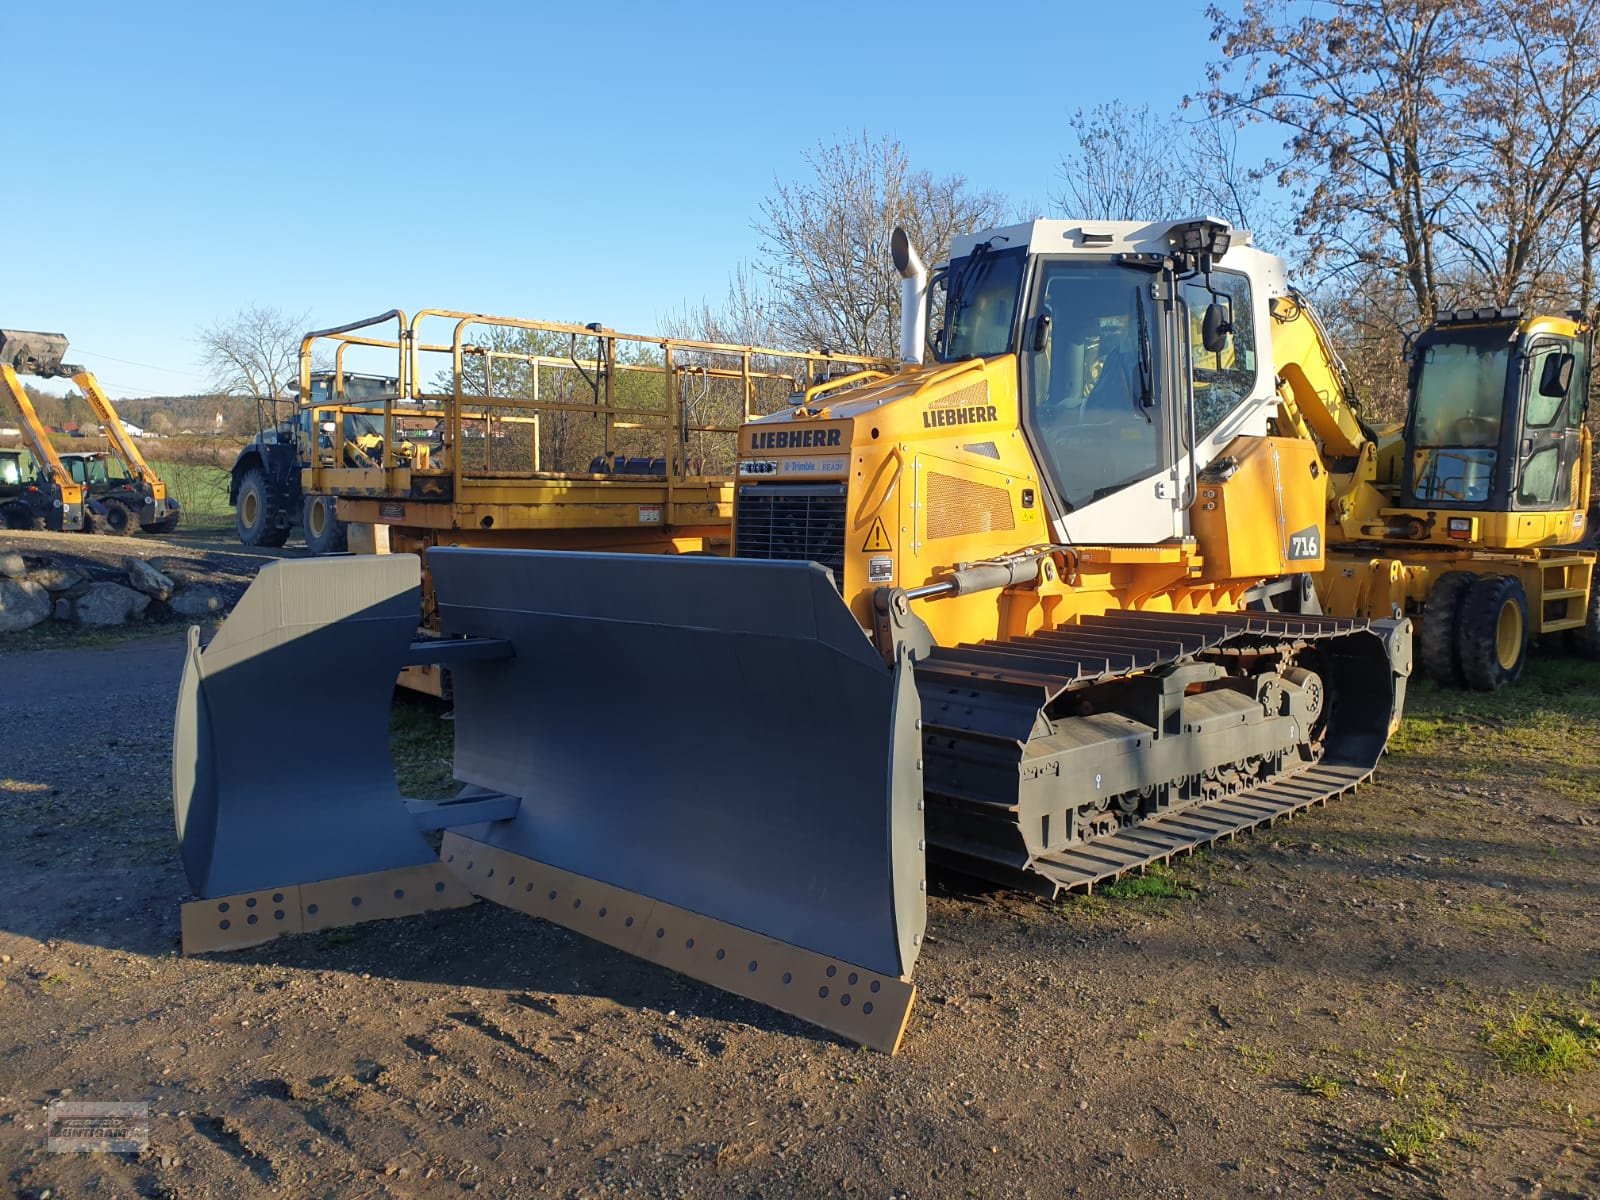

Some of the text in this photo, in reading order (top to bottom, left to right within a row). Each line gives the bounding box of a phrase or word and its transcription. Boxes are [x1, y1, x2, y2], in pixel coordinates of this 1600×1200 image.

[922, 405, 998, 429] LIEBHERR
[751, 429, 841, 450] LIEBHERR
[791, 461, 843, 472] Trimble READY
[1292, 536, 1318, 557] 716
